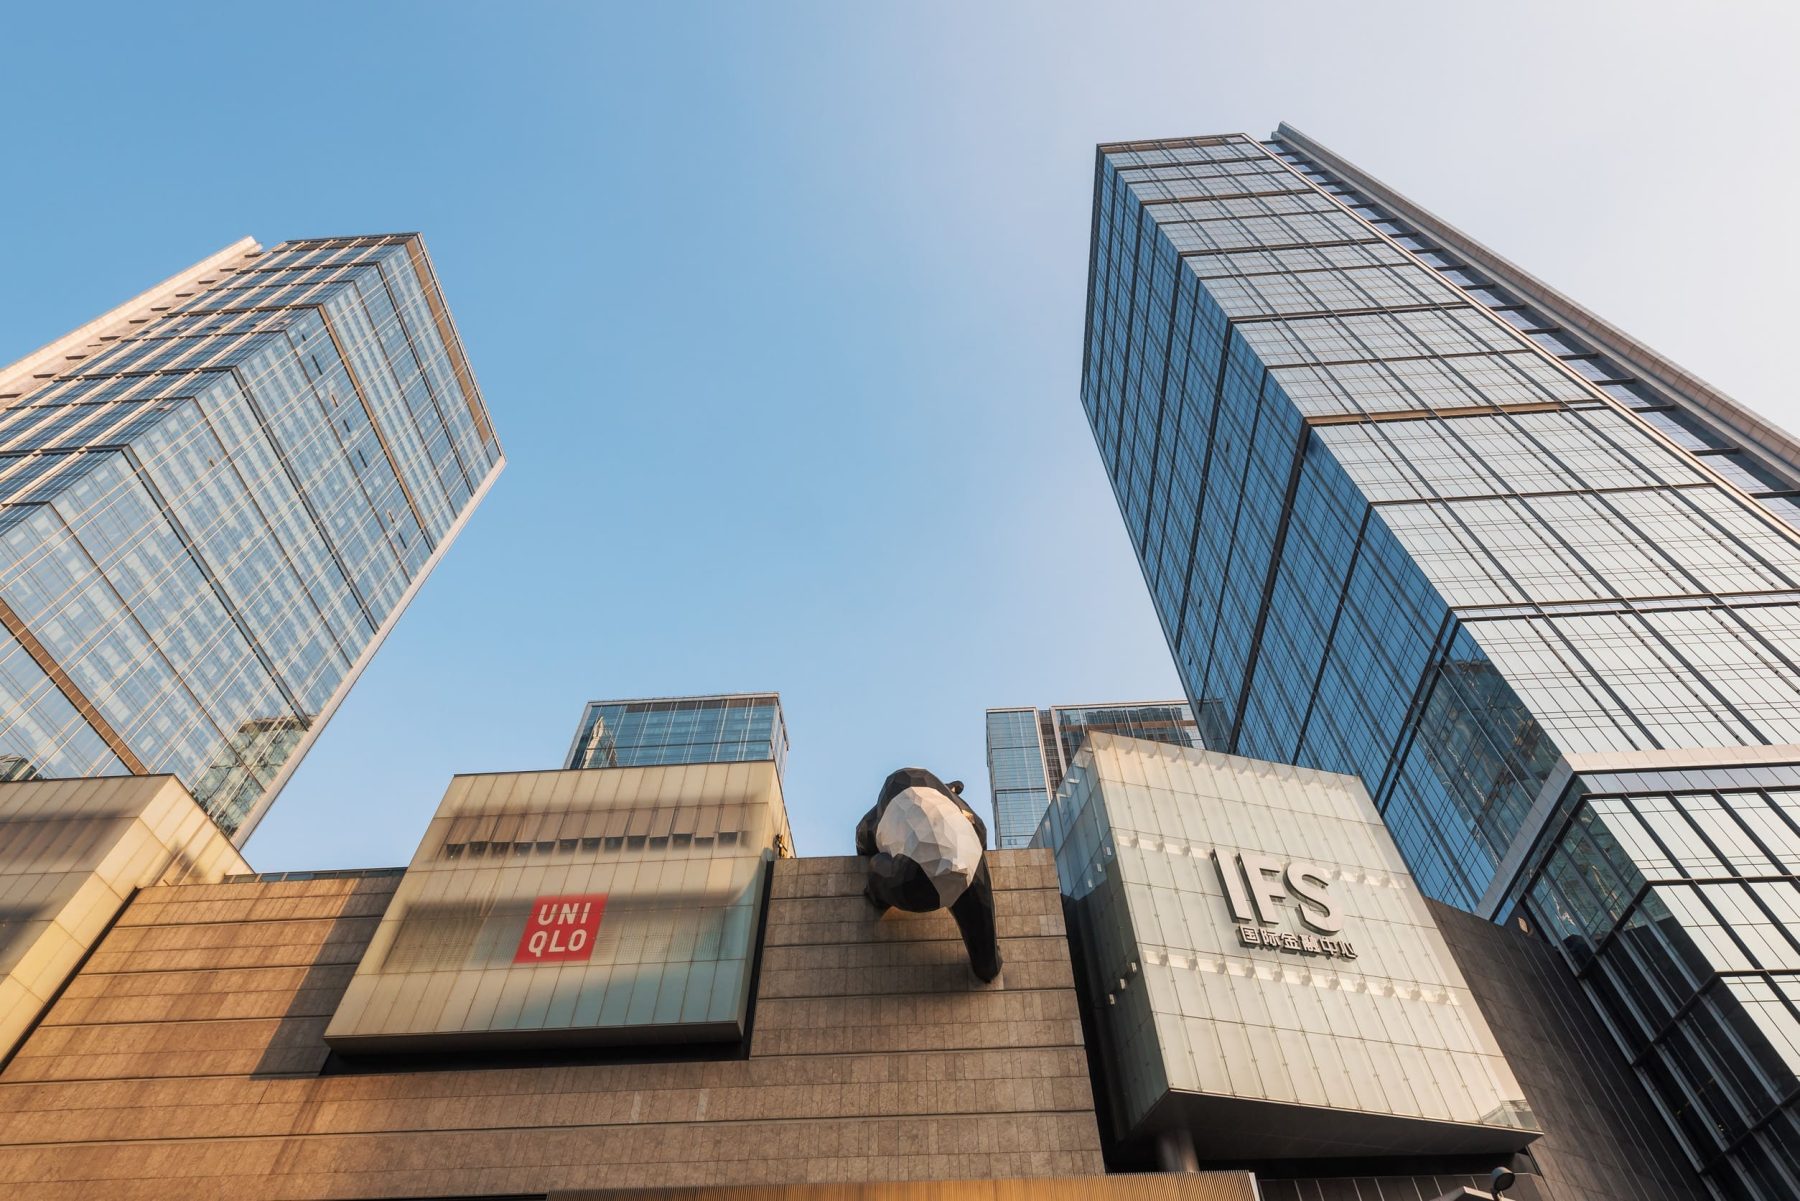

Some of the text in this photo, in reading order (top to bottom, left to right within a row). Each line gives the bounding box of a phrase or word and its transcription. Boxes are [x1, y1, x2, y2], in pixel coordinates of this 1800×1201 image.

[1211, 848, 1344, 935] IFS
[537, 902, 592, 926] UNI
[528, 928, 588, 958] QLO
[1238, 924, 1358, 960] 国际金融中心
